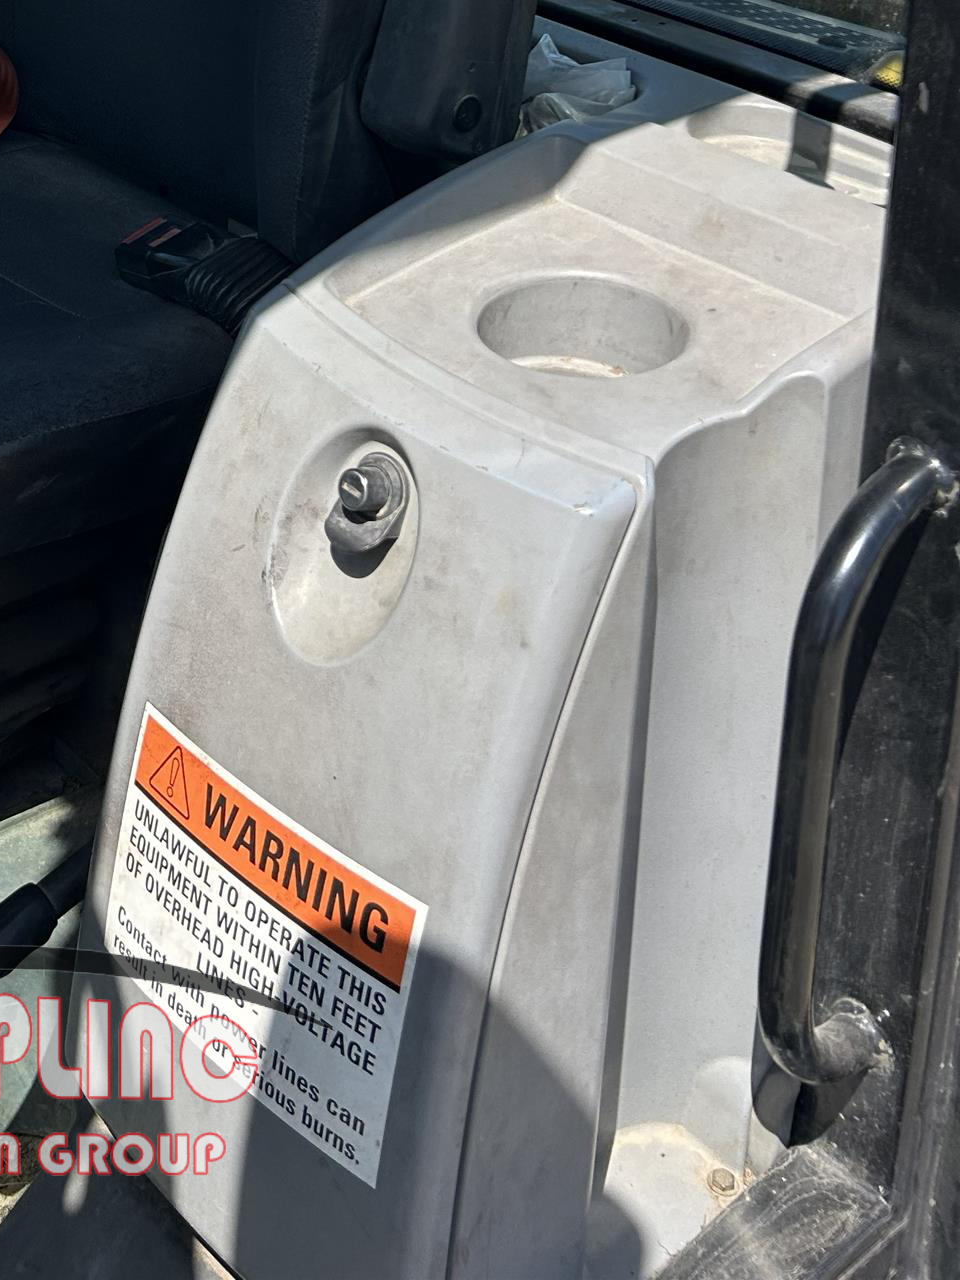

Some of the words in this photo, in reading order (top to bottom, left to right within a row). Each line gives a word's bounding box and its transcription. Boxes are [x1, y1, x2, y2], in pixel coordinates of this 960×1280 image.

[126, 852, 143, 879] OF
[145, 872, 225, 959] OVERHEAD
[229, 950, 377, 1076] HIGH-VOLTAGE
[129, 825, 213, 916] EQUIPMENT
[217, 905, 282, 976] WITHIN
[288, 962, 326, 1008] TEN
[331, 995, 382, 1045] FEET
[134, 799, 212, 888] UNLAWFUL
[218, 875, 240, 909] TO
[244, 900, 332, 980] OPERATE
[338, 965, 387, 1016] THIS
[204, 782, 390, 954] WARNING
[113, 934, 148, 981] result
[151, 971, 163, 998] in
[167, 992, 207, 1041] death
[212, 1038, 229, 1058] or
[234, 1055, 297, 1116] serious
[301, 1104, 360, 1166] burns.
[118, 905, 168, 972] Contact
[171, 966, 205, 1009] with
[210, 1003, 267, 1060] power
[272, 1049, 320, 1103] lines
[326, 1098, 365, 1136] can
[196, 952, 246, 1009] LINES
